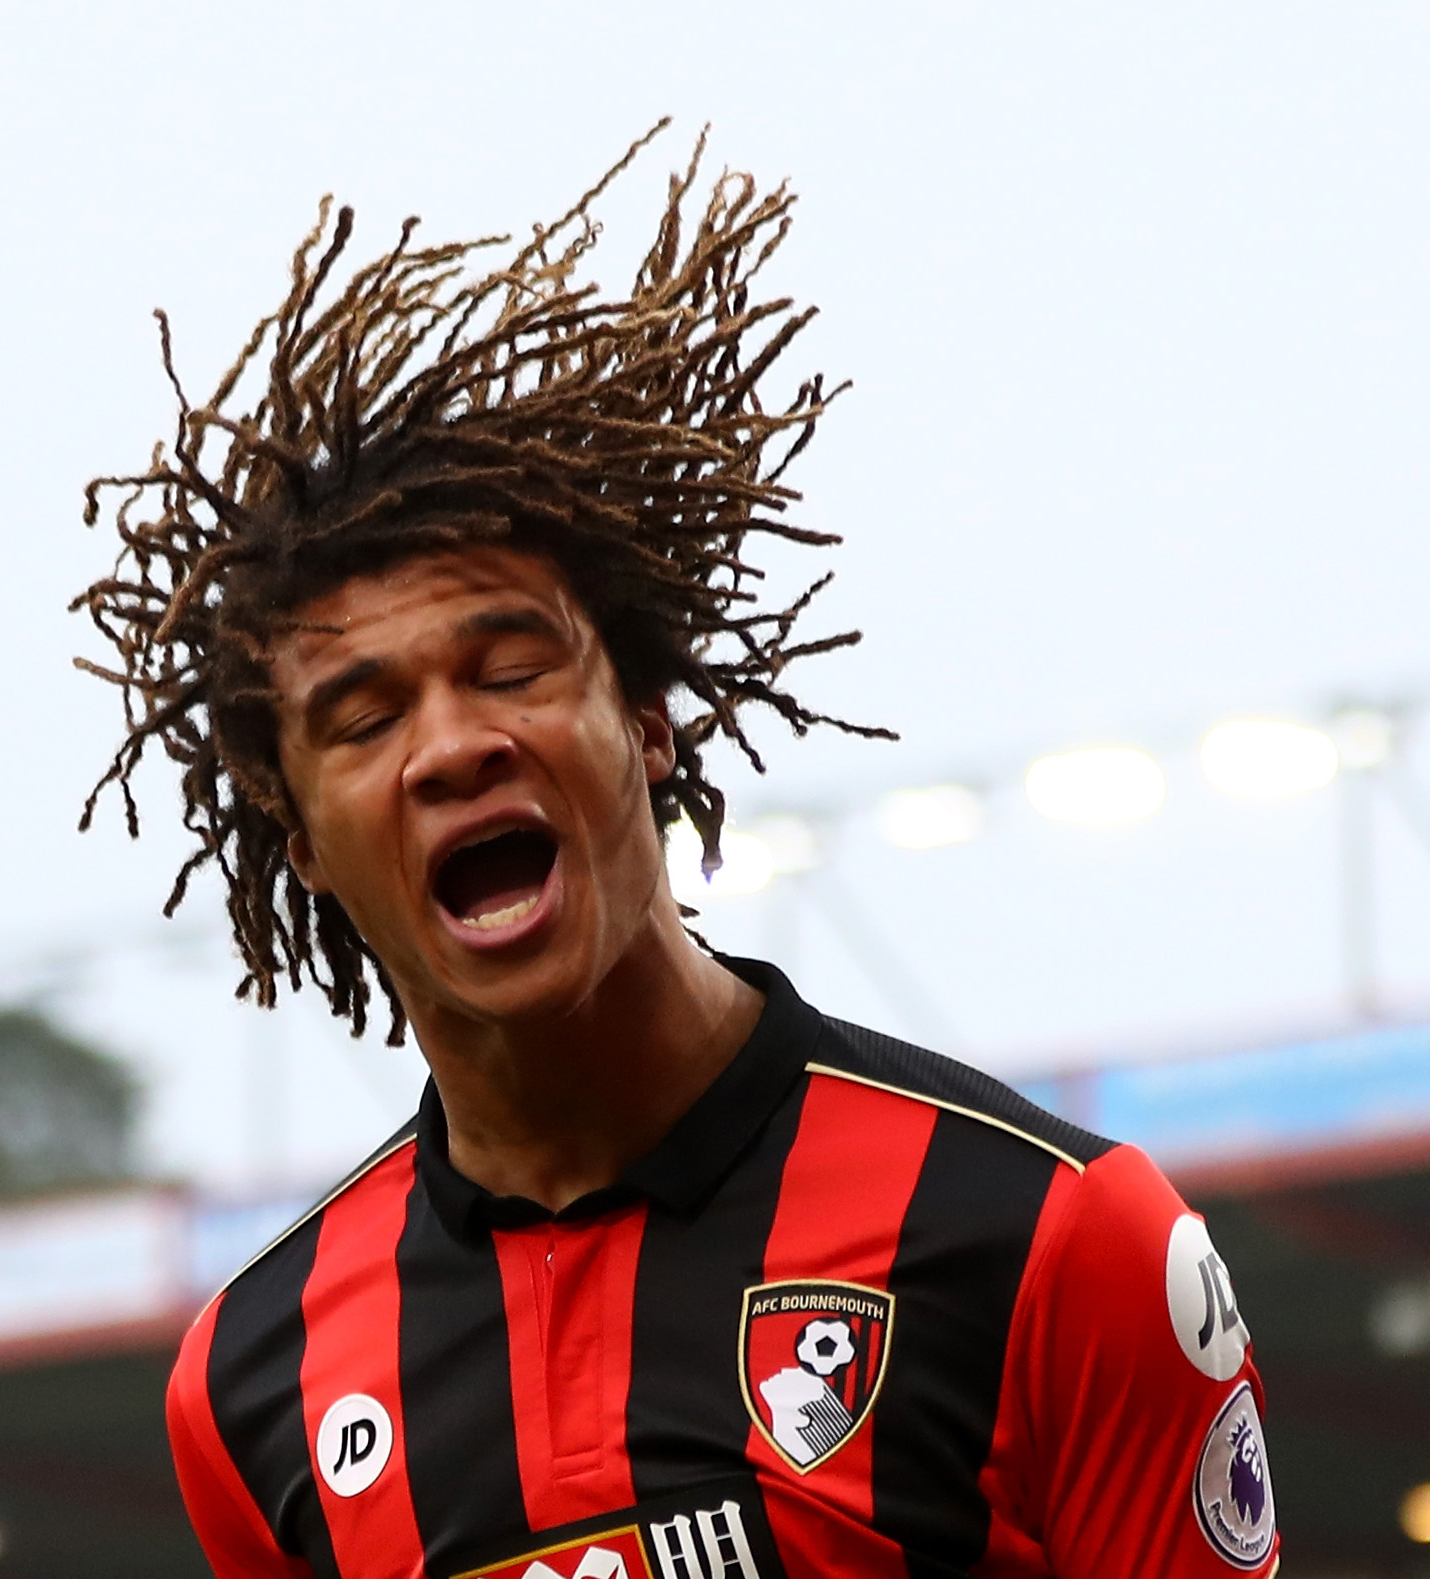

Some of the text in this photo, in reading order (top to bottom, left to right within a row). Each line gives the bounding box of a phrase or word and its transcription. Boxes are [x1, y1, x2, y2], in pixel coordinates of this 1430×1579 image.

[752, 1295, 885, 1321] AFC BOURNEMOUTH
[333, 1418, 377, 1476] JD
